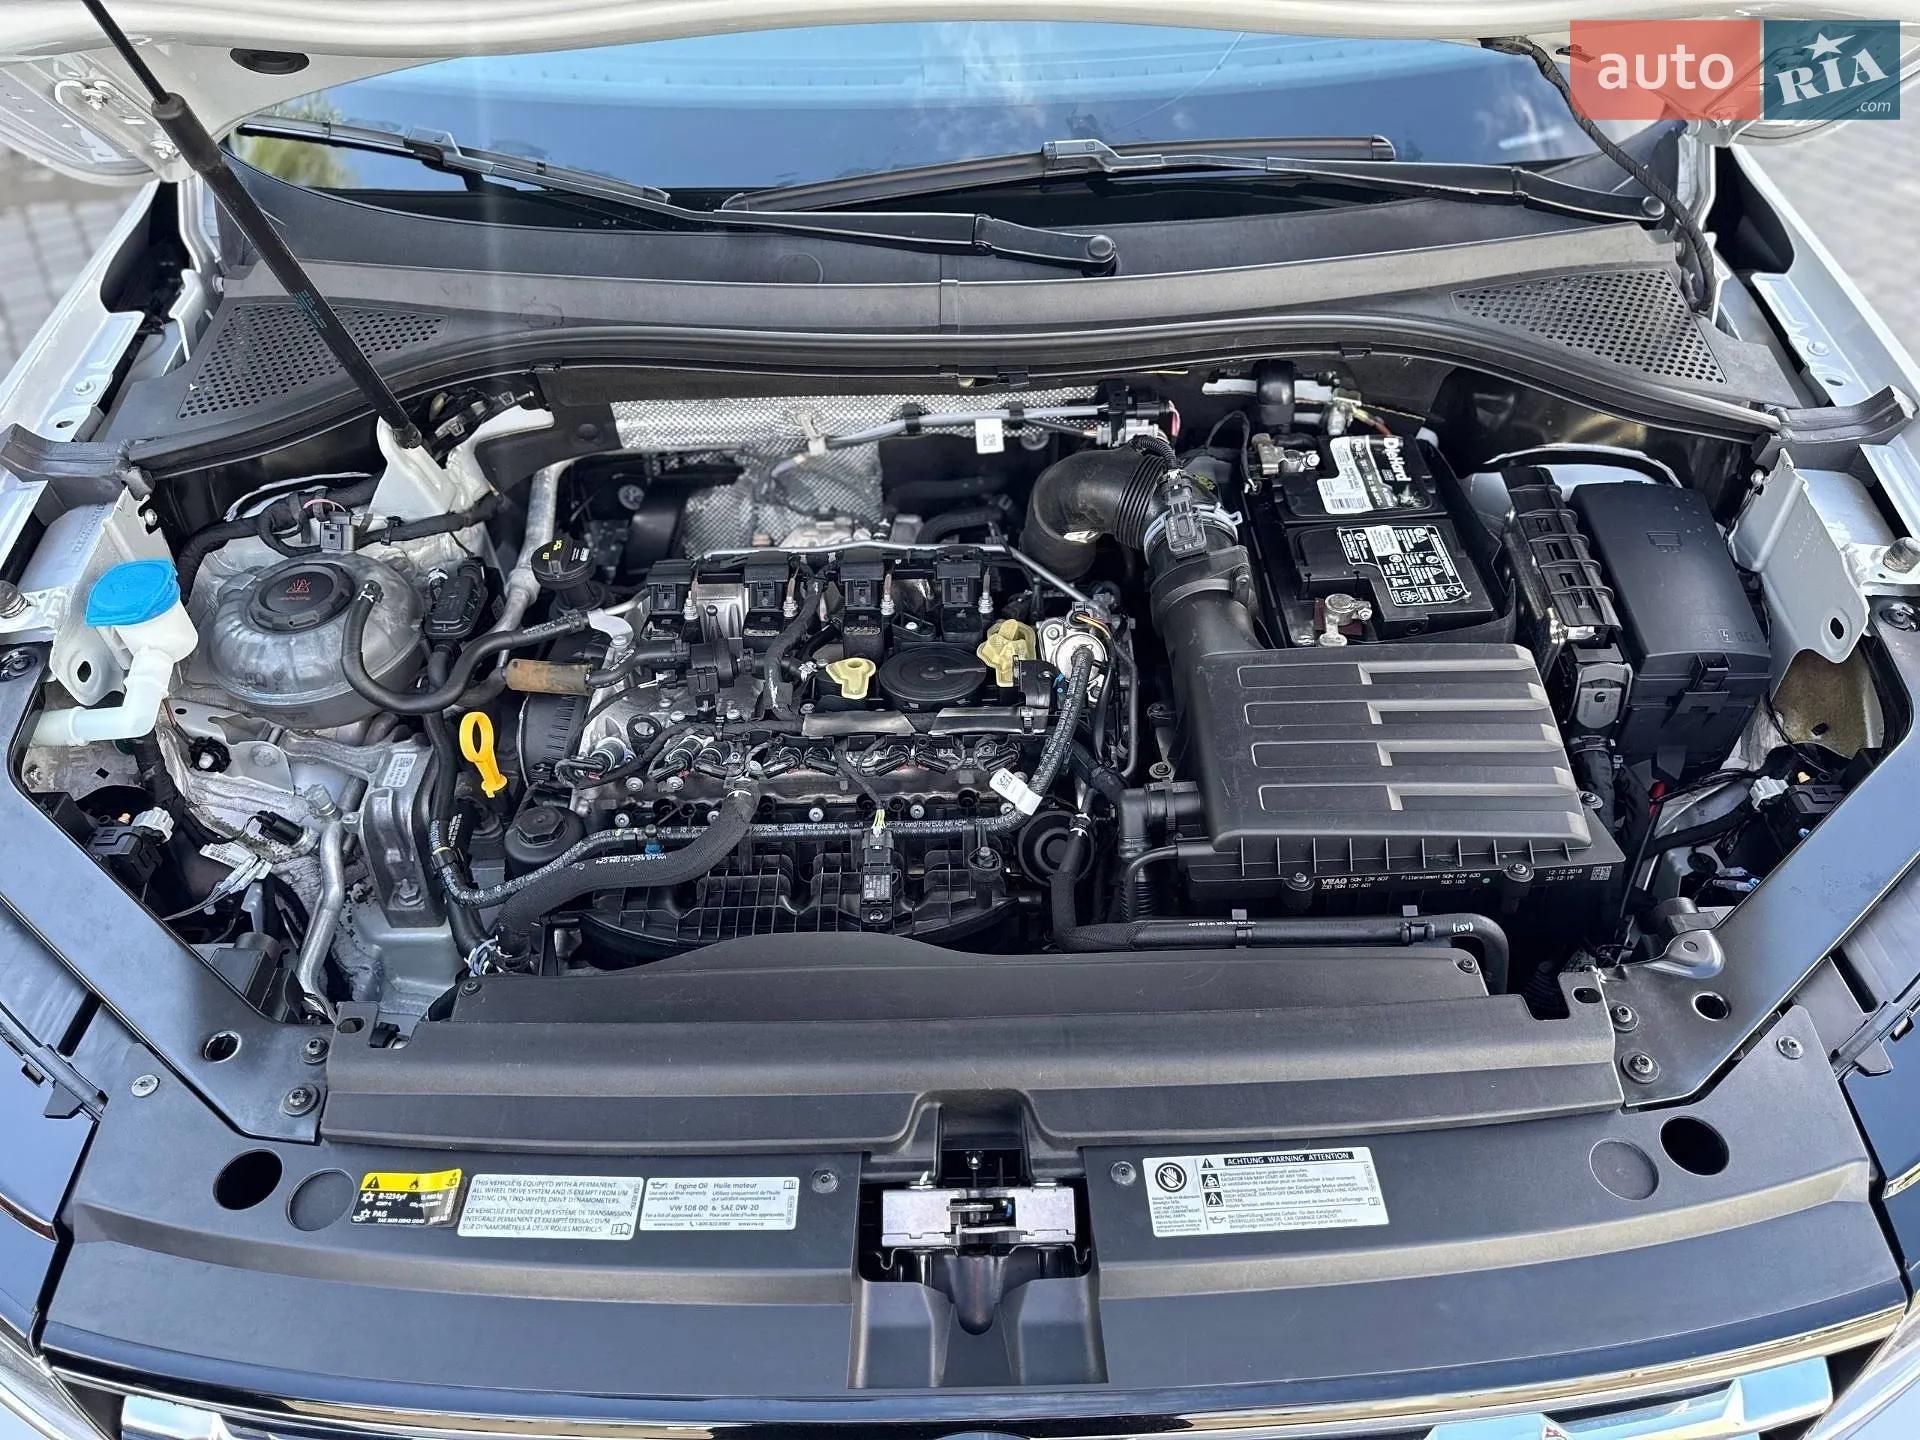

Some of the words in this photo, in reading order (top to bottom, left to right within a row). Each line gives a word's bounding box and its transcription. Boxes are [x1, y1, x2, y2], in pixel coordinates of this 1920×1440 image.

[1384, 437, 1411, 481] DieHard
[1228, 1157, 1264, 1165] ACHTUNG
[1268, 1155, 1305, 1163] WARNING
[1308, 1153, 1349, 1161] ATTENTION
